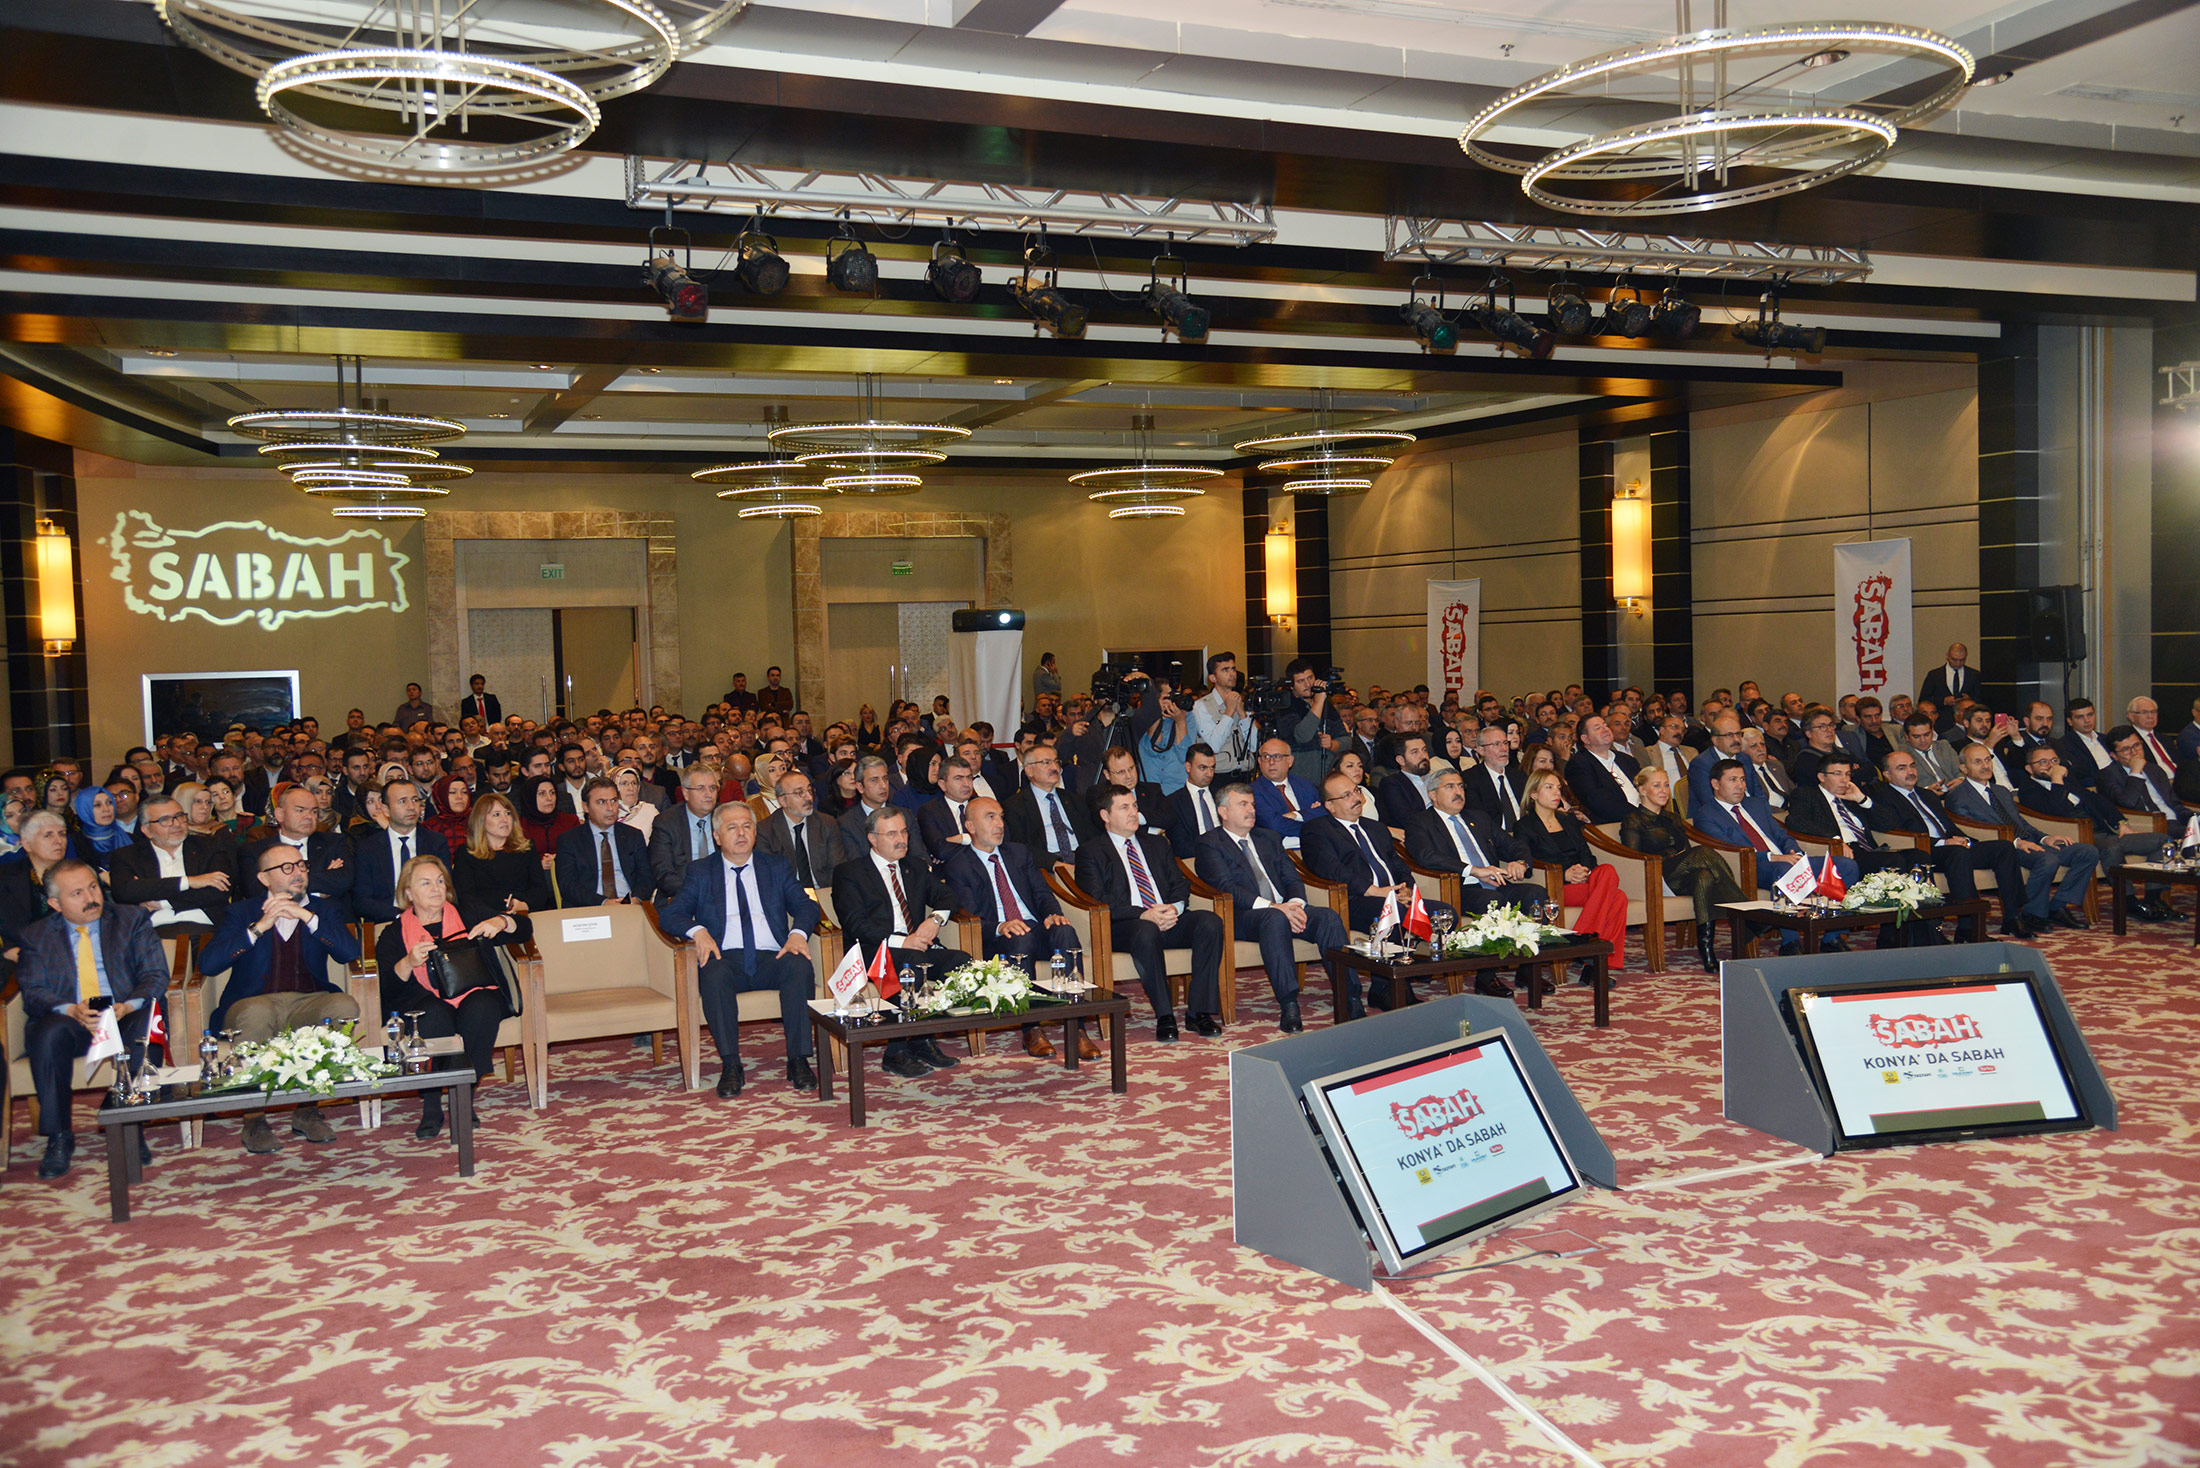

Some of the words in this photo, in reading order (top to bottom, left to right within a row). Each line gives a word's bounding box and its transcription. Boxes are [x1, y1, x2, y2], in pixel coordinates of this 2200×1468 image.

[149, 551, 375, 600] SABAH
[541, 568, 563, 578] EXIT
[1445, 607, 1464, 689] SABAH
[1860, 581, 1885, 686] SABAH
[1876, 1017, 1976, 1044] SABAH
[1926, 1053, 1949, 1064] DA
[1951, 1048, 2005, 1062] SABAH
[1397, 1092, 1480, 1137] SABAH
[1446, 1138, 1466, 1153] DA
[1465, 1122, 1507, 1146] SABAH
